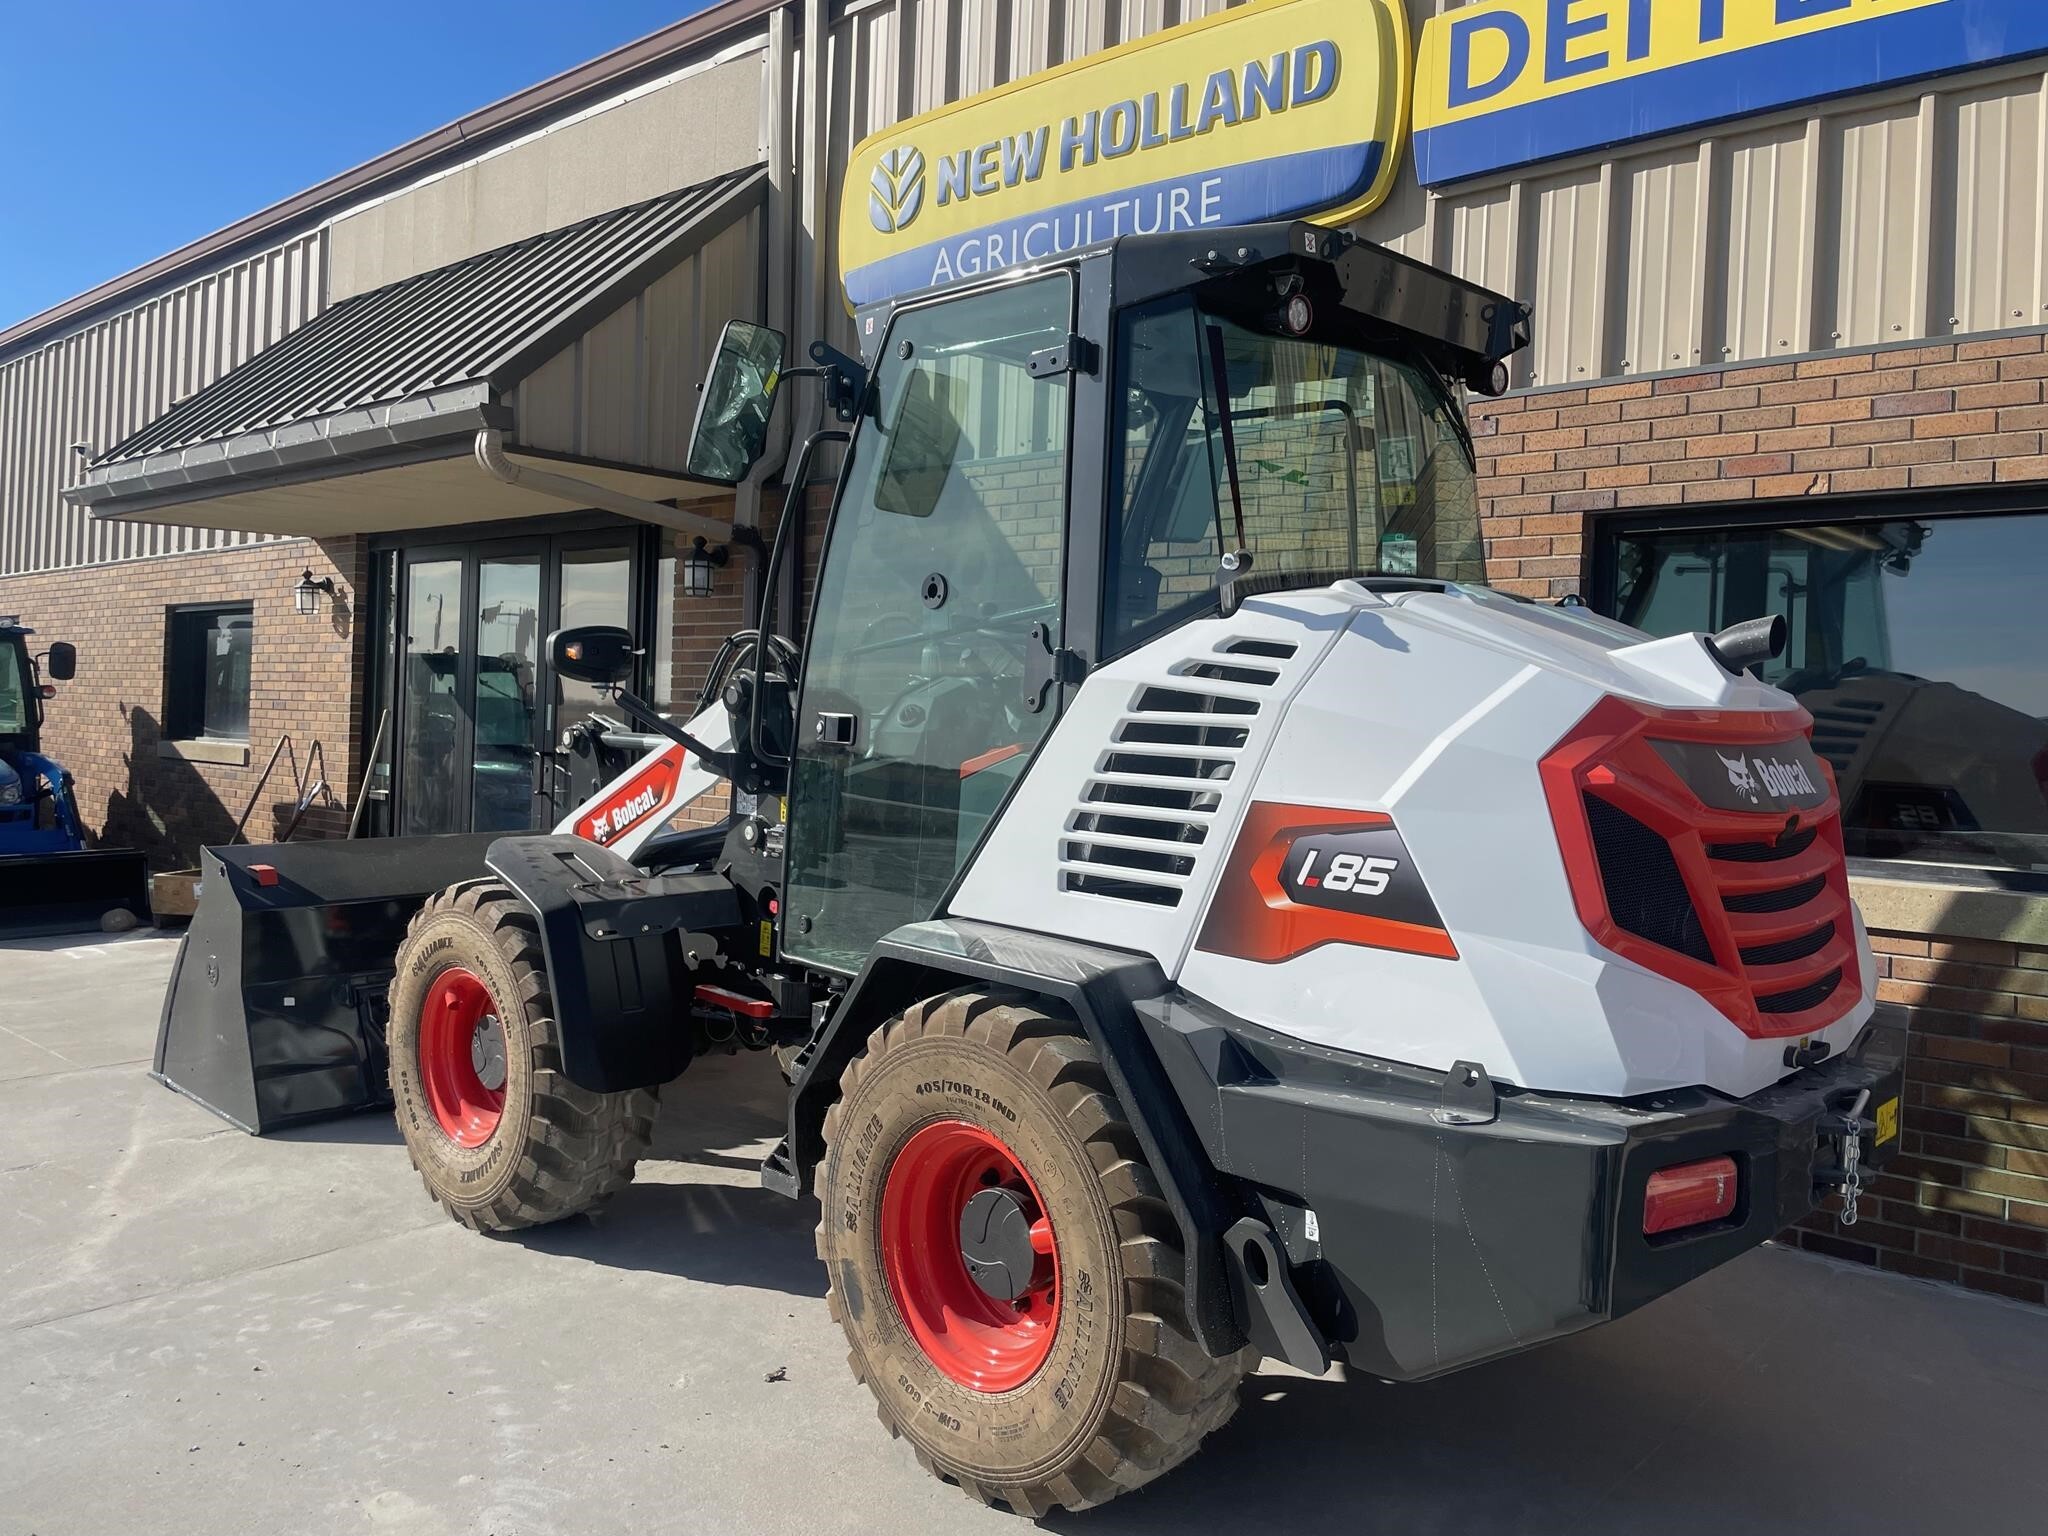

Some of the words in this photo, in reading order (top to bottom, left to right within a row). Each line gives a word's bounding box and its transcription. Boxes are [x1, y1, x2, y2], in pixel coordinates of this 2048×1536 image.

[936, 123, 1051, 207] NEW
[1059, 39, 1342, 172] HOLLAND
[1752, 757, 1817, 798] Bobcat
[611, 785, 656, 832] Bobcat
[417, 937, 454, 972] ALLIANCE
[991, 1099, 1017, 1122] IND
[846, 1113, 883, 1216] ALLIANCE
[1055, 1289, 1093, 1410] ALLIANCE
